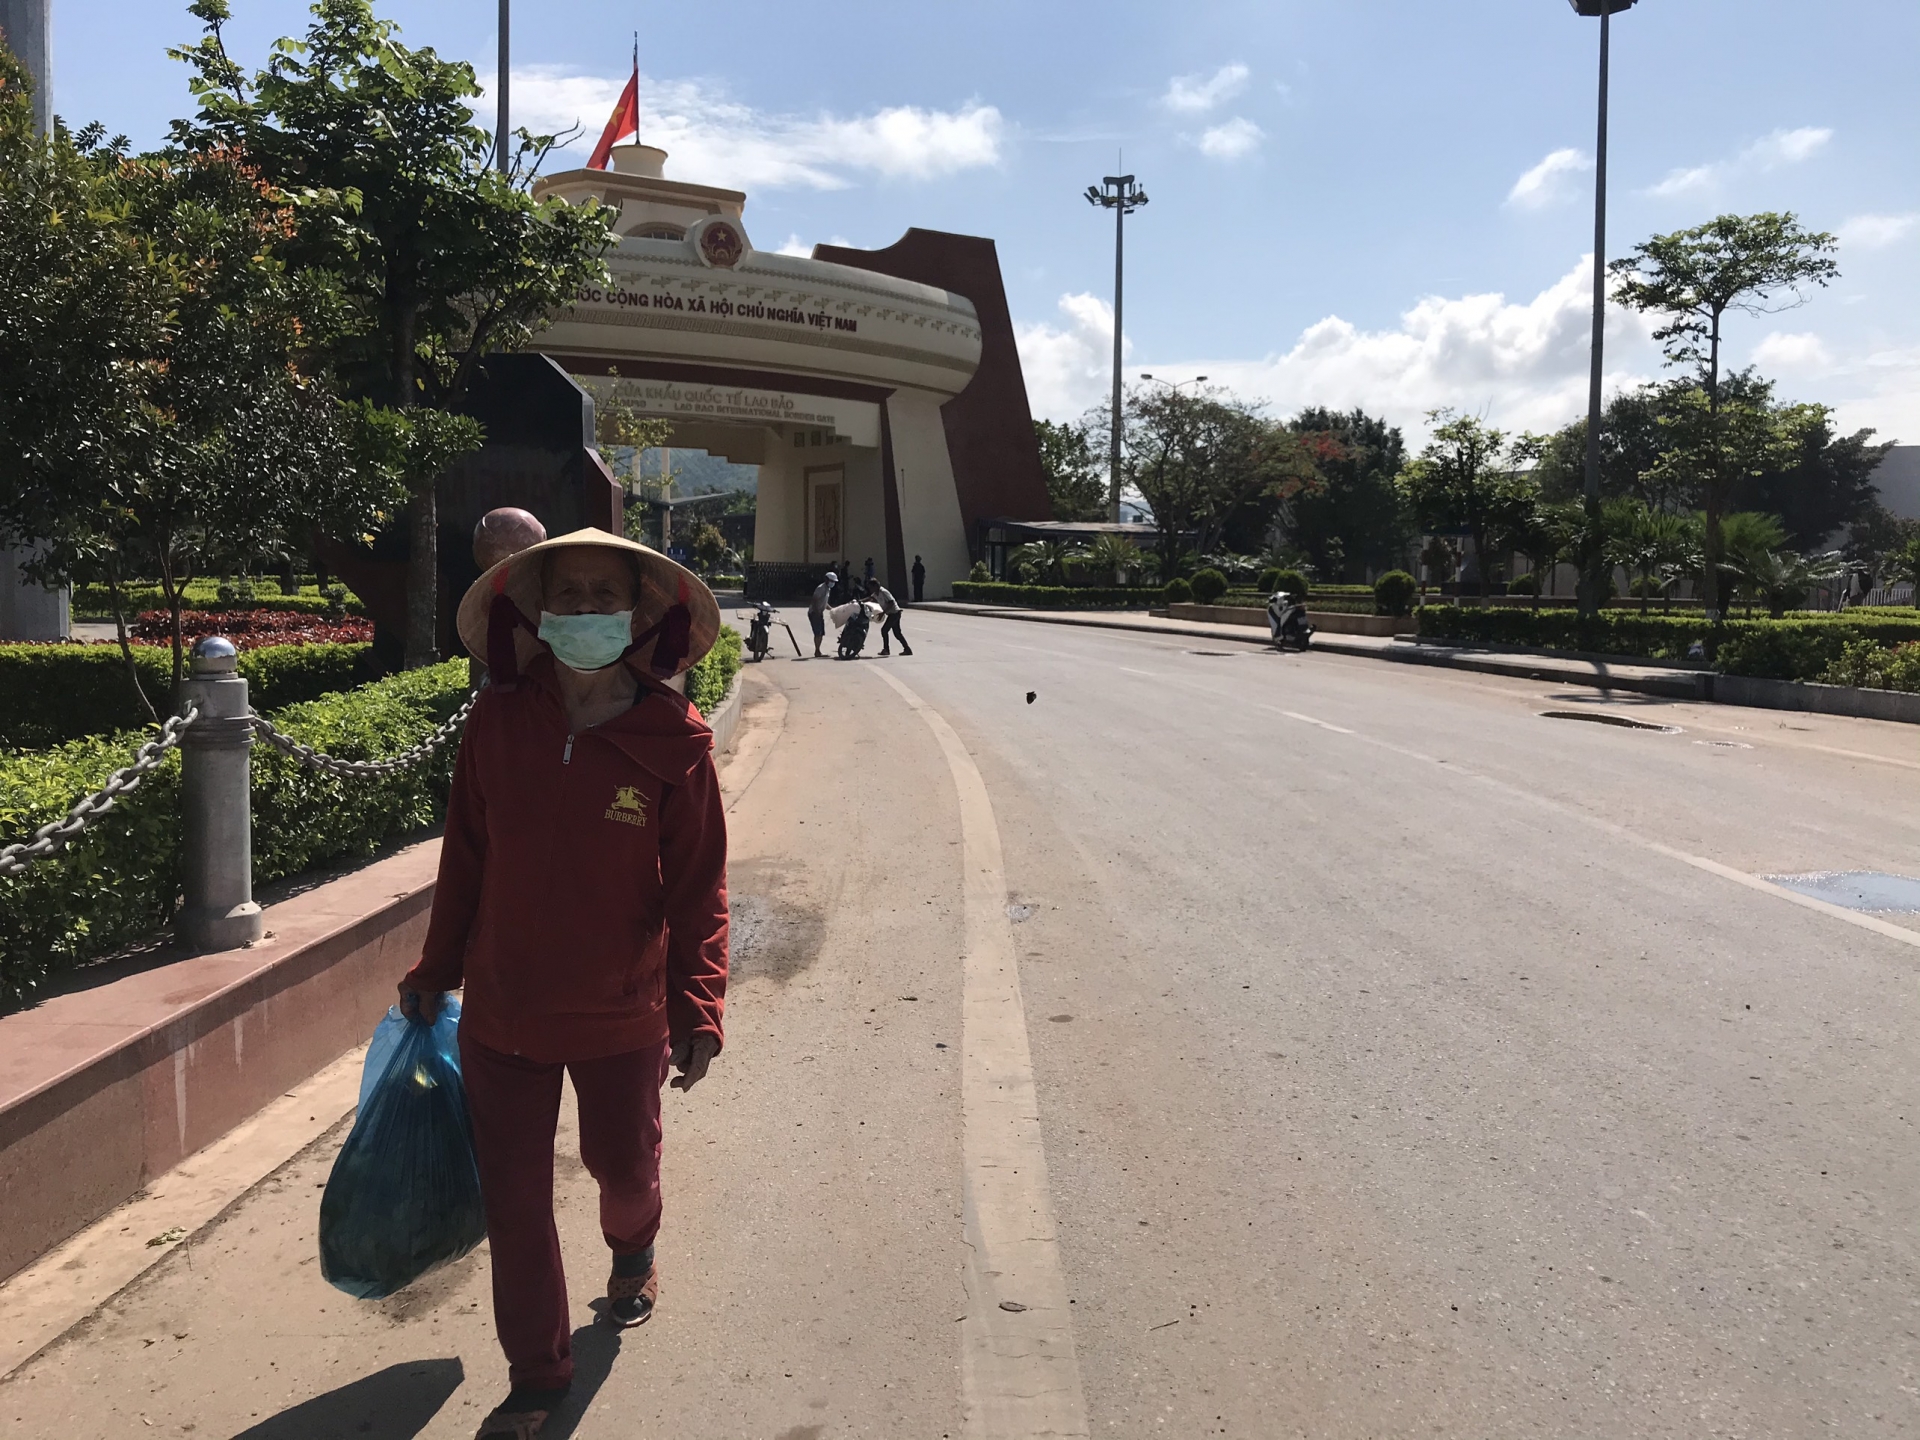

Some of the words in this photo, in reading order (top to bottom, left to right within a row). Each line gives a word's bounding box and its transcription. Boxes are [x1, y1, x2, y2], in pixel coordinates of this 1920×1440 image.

[606, 288, 649, 309] CỘNG
[653, 291, 684, 311] HÒA
[687, 295, 706, 312] XÃ
[710, 298, 733, 318] HỘI
[737, 301, 765, 319] CHỦ
[767, 307, 805, 324] NGHĨA
[807, 311, 833, 331] VIỆT
[834, 316, 858, 333] NAM
[684, 387, 723, 405] QUỐC
[726, 390, 743, 405] TẾ
[744, 395, 768, 408] LAO
[770, 394, 794, 410] BẢO
[674, 402, 693, 412] LAO
[694, 403, 714, 413] BAO
[716, 405, 780, 418] INTERNATIONAL
[816, 414, 835, 424] GATE
[604, 808, 648, 827] BURBERRY
